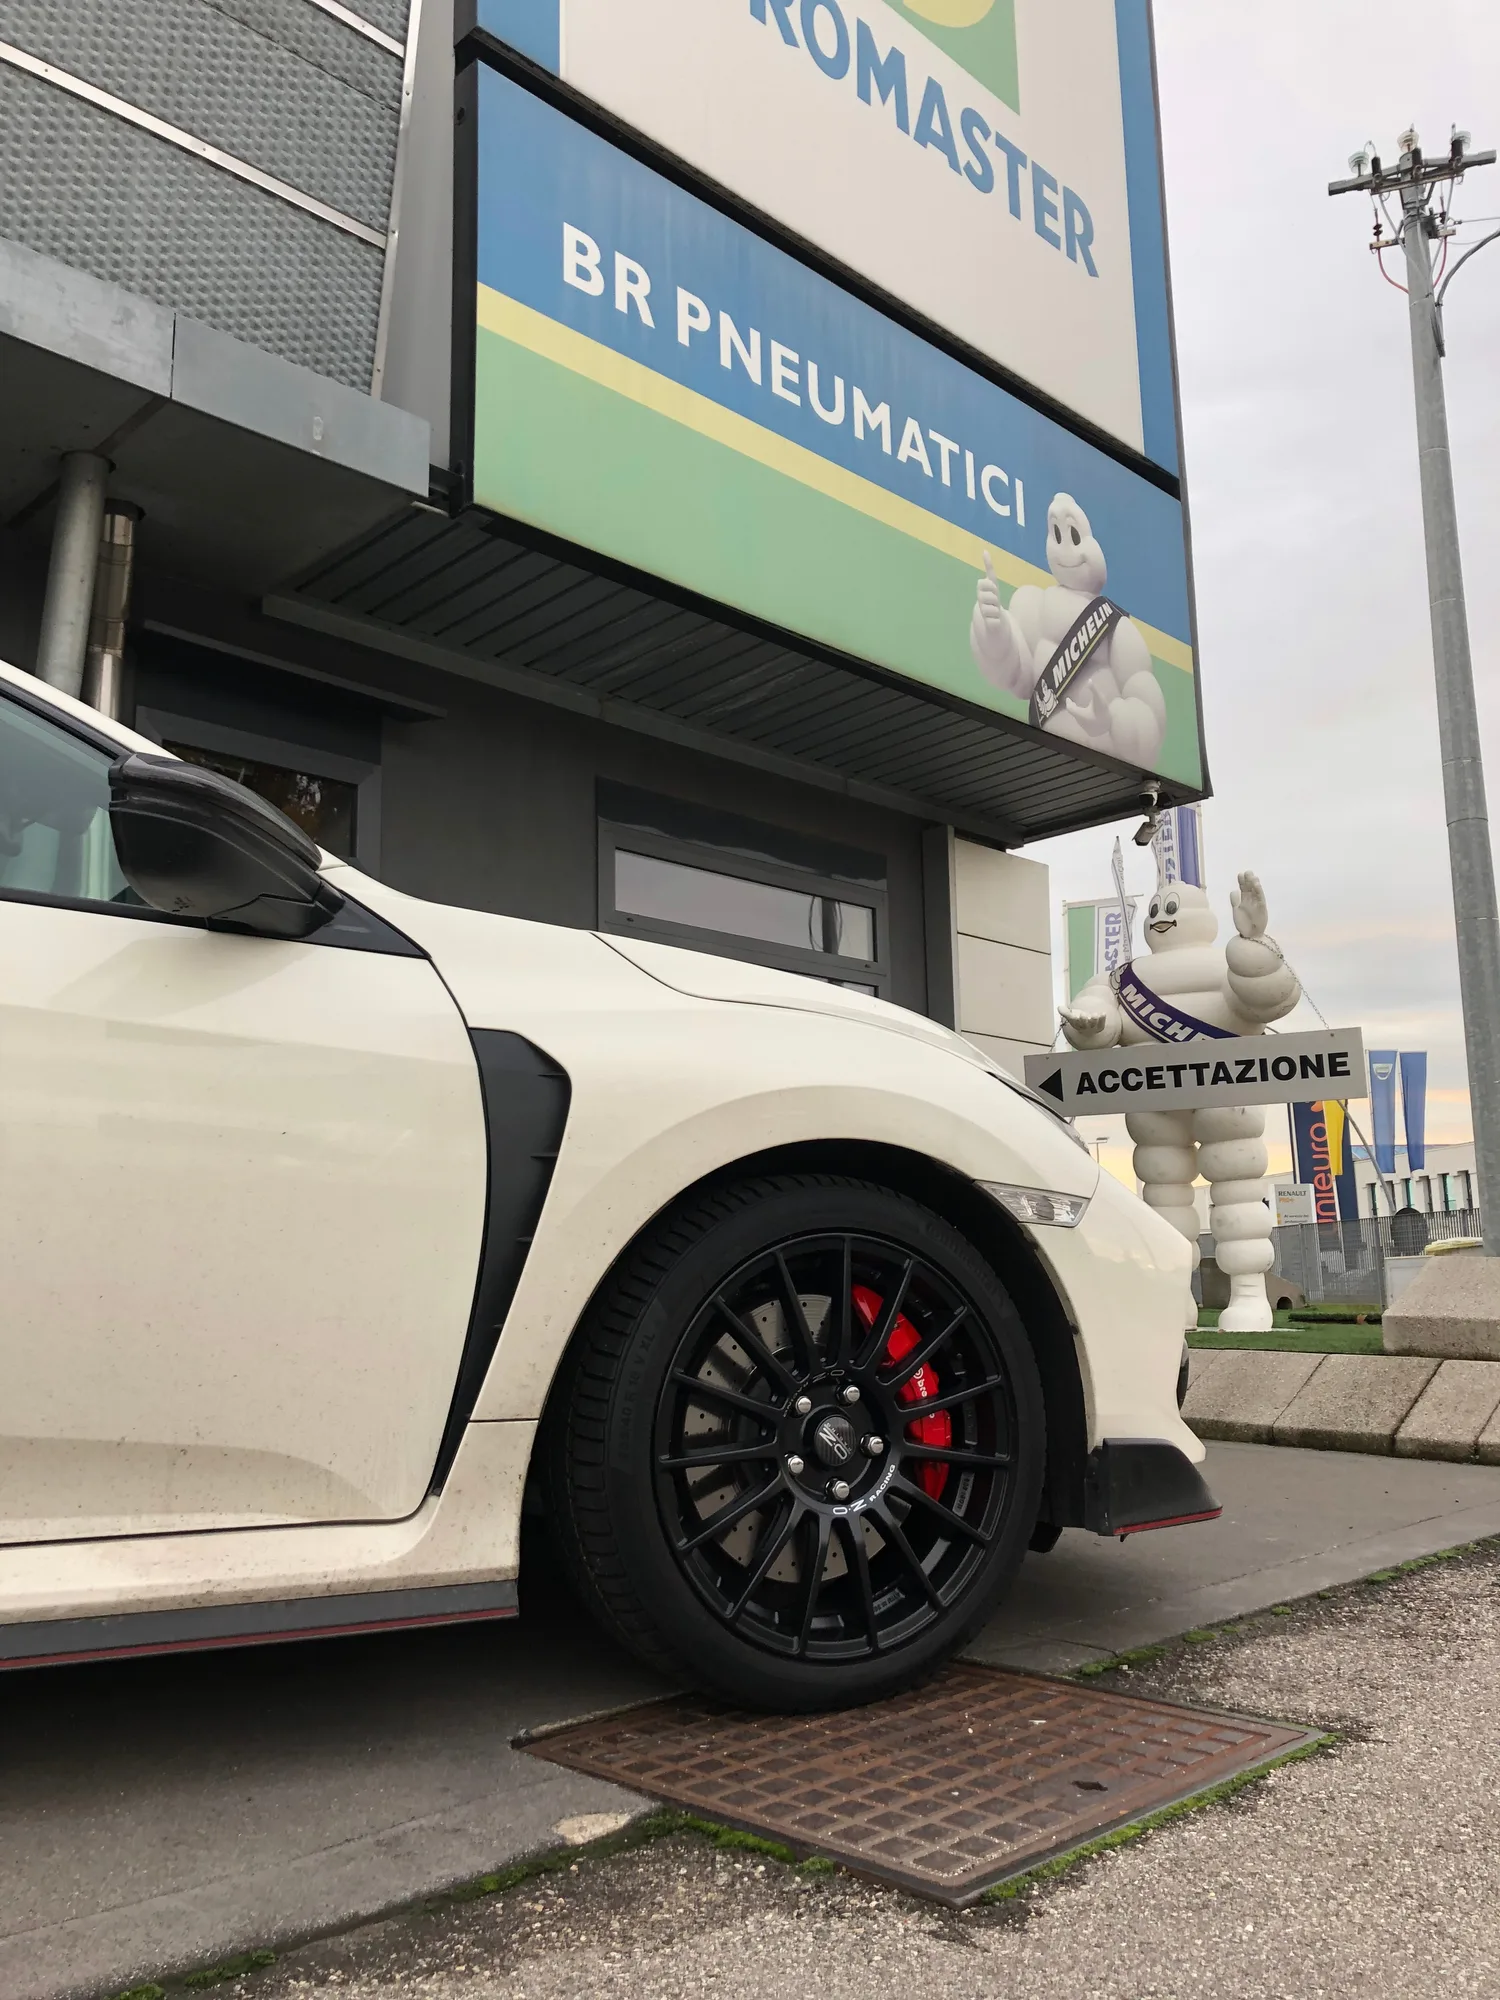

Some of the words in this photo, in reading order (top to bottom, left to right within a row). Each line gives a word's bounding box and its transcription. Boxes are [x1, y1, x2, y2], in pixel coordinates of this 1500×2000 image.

[563, 222, 655, 329] BR
[677, 286, 1026, 527] PNEUMATICI
[1052, 602, 1113, 689] MICHELIN
[1121, 983, 1216, 1042] MICH
[1076, 1051, 1351, 1096] ACCETTAZIONE
[868, 1464, 896, 1502] RACING
